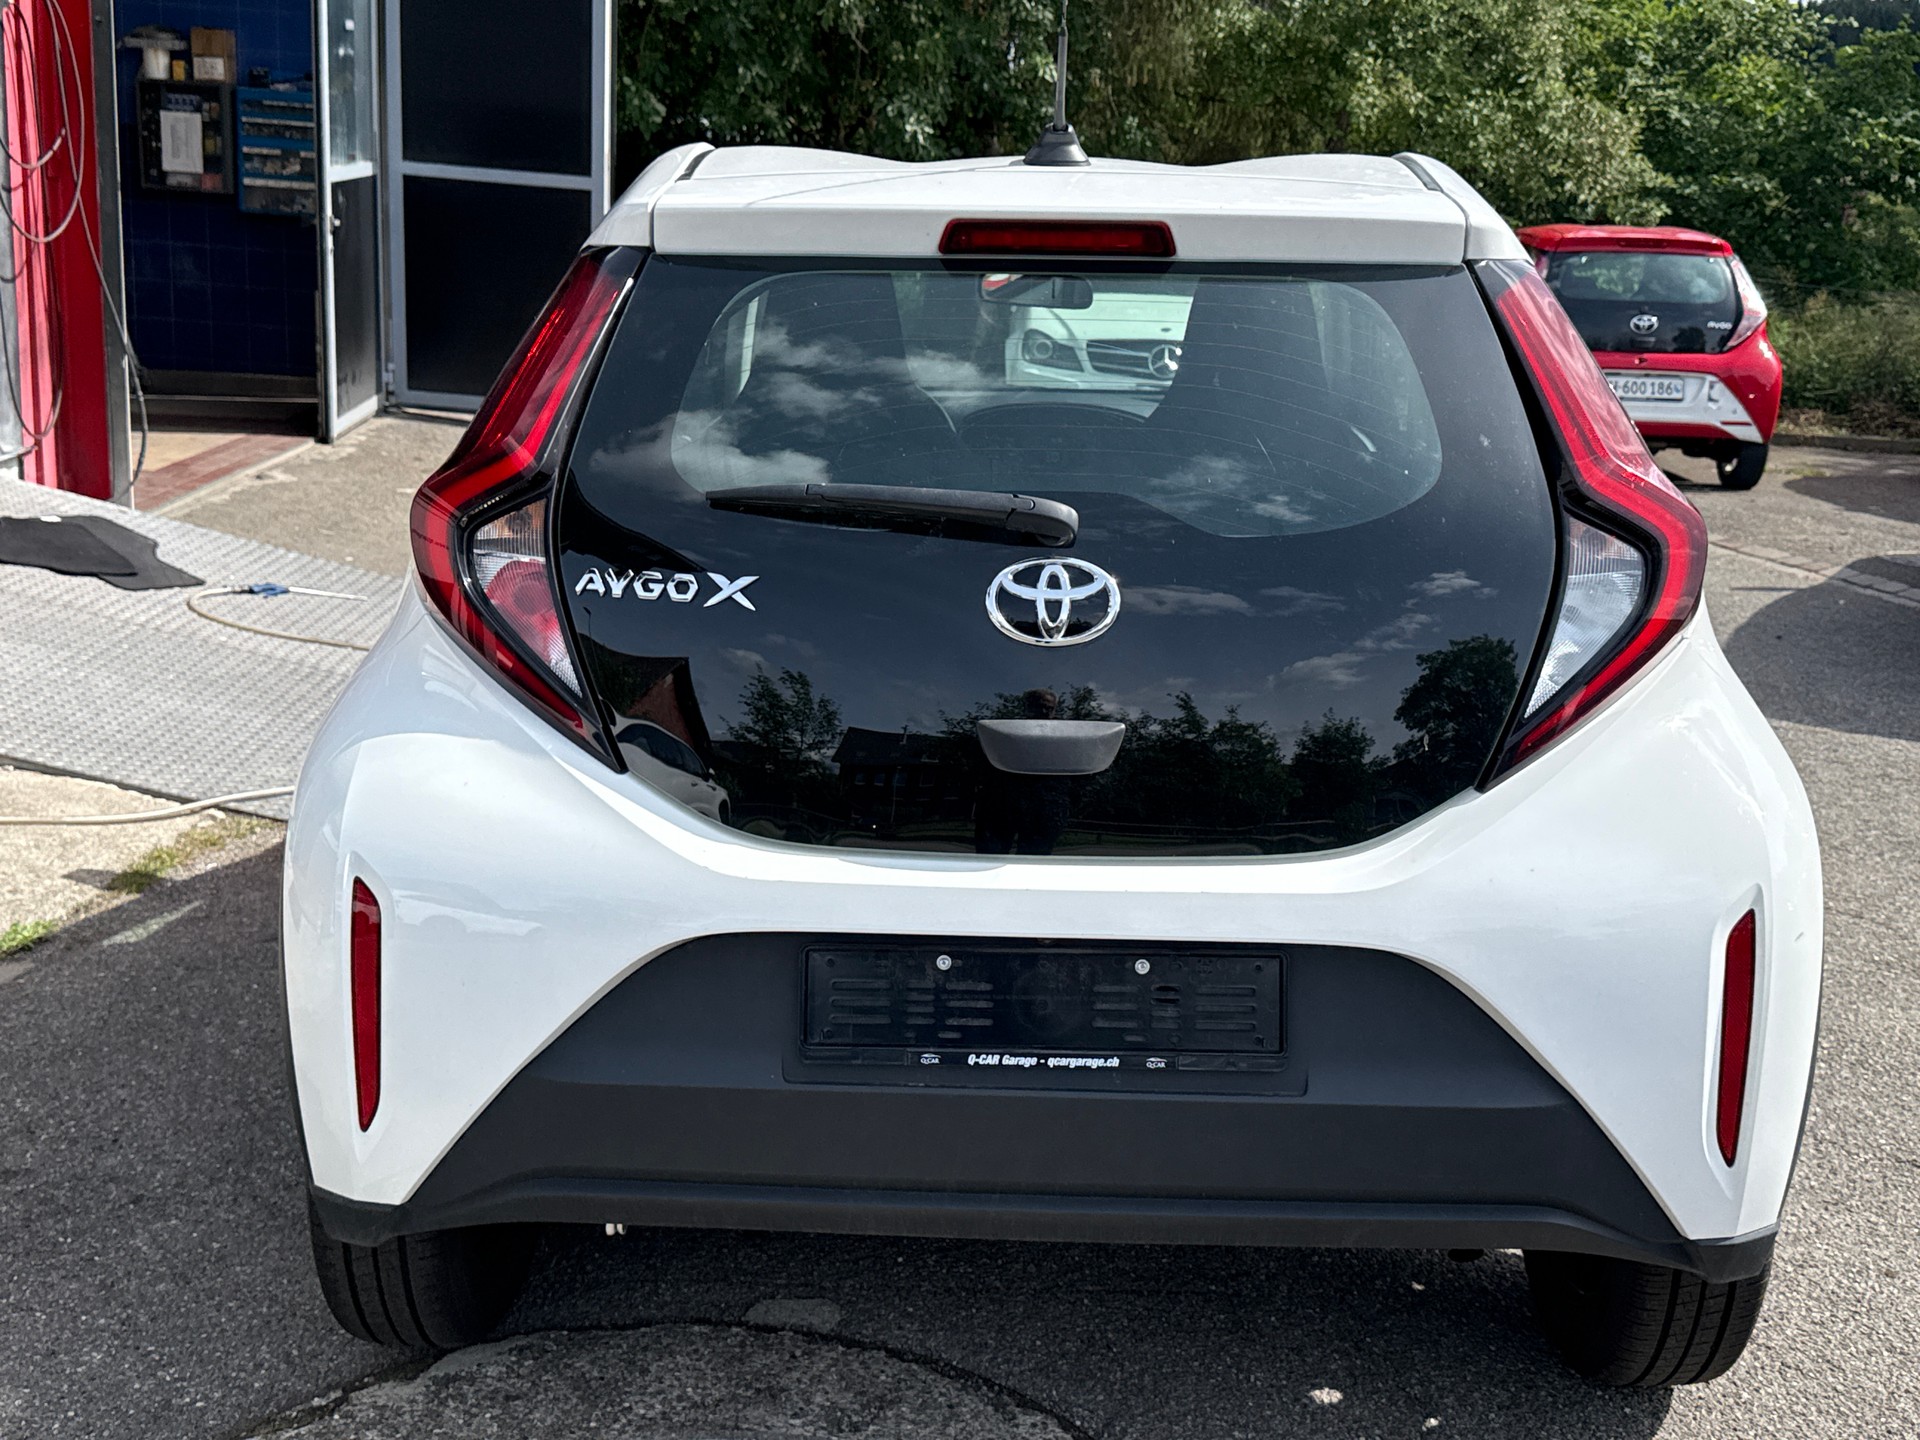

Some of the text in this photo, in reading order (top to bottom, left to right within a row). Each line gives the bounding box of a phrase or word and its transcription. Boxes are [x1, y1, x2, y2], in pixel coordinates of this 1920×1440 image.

[967, 1054, 1000, 1066] Q-CAR
[1001, 1054, 1038, 1067] Garage
[1047, 1056, 1120, 1069] qcargarage.ch
